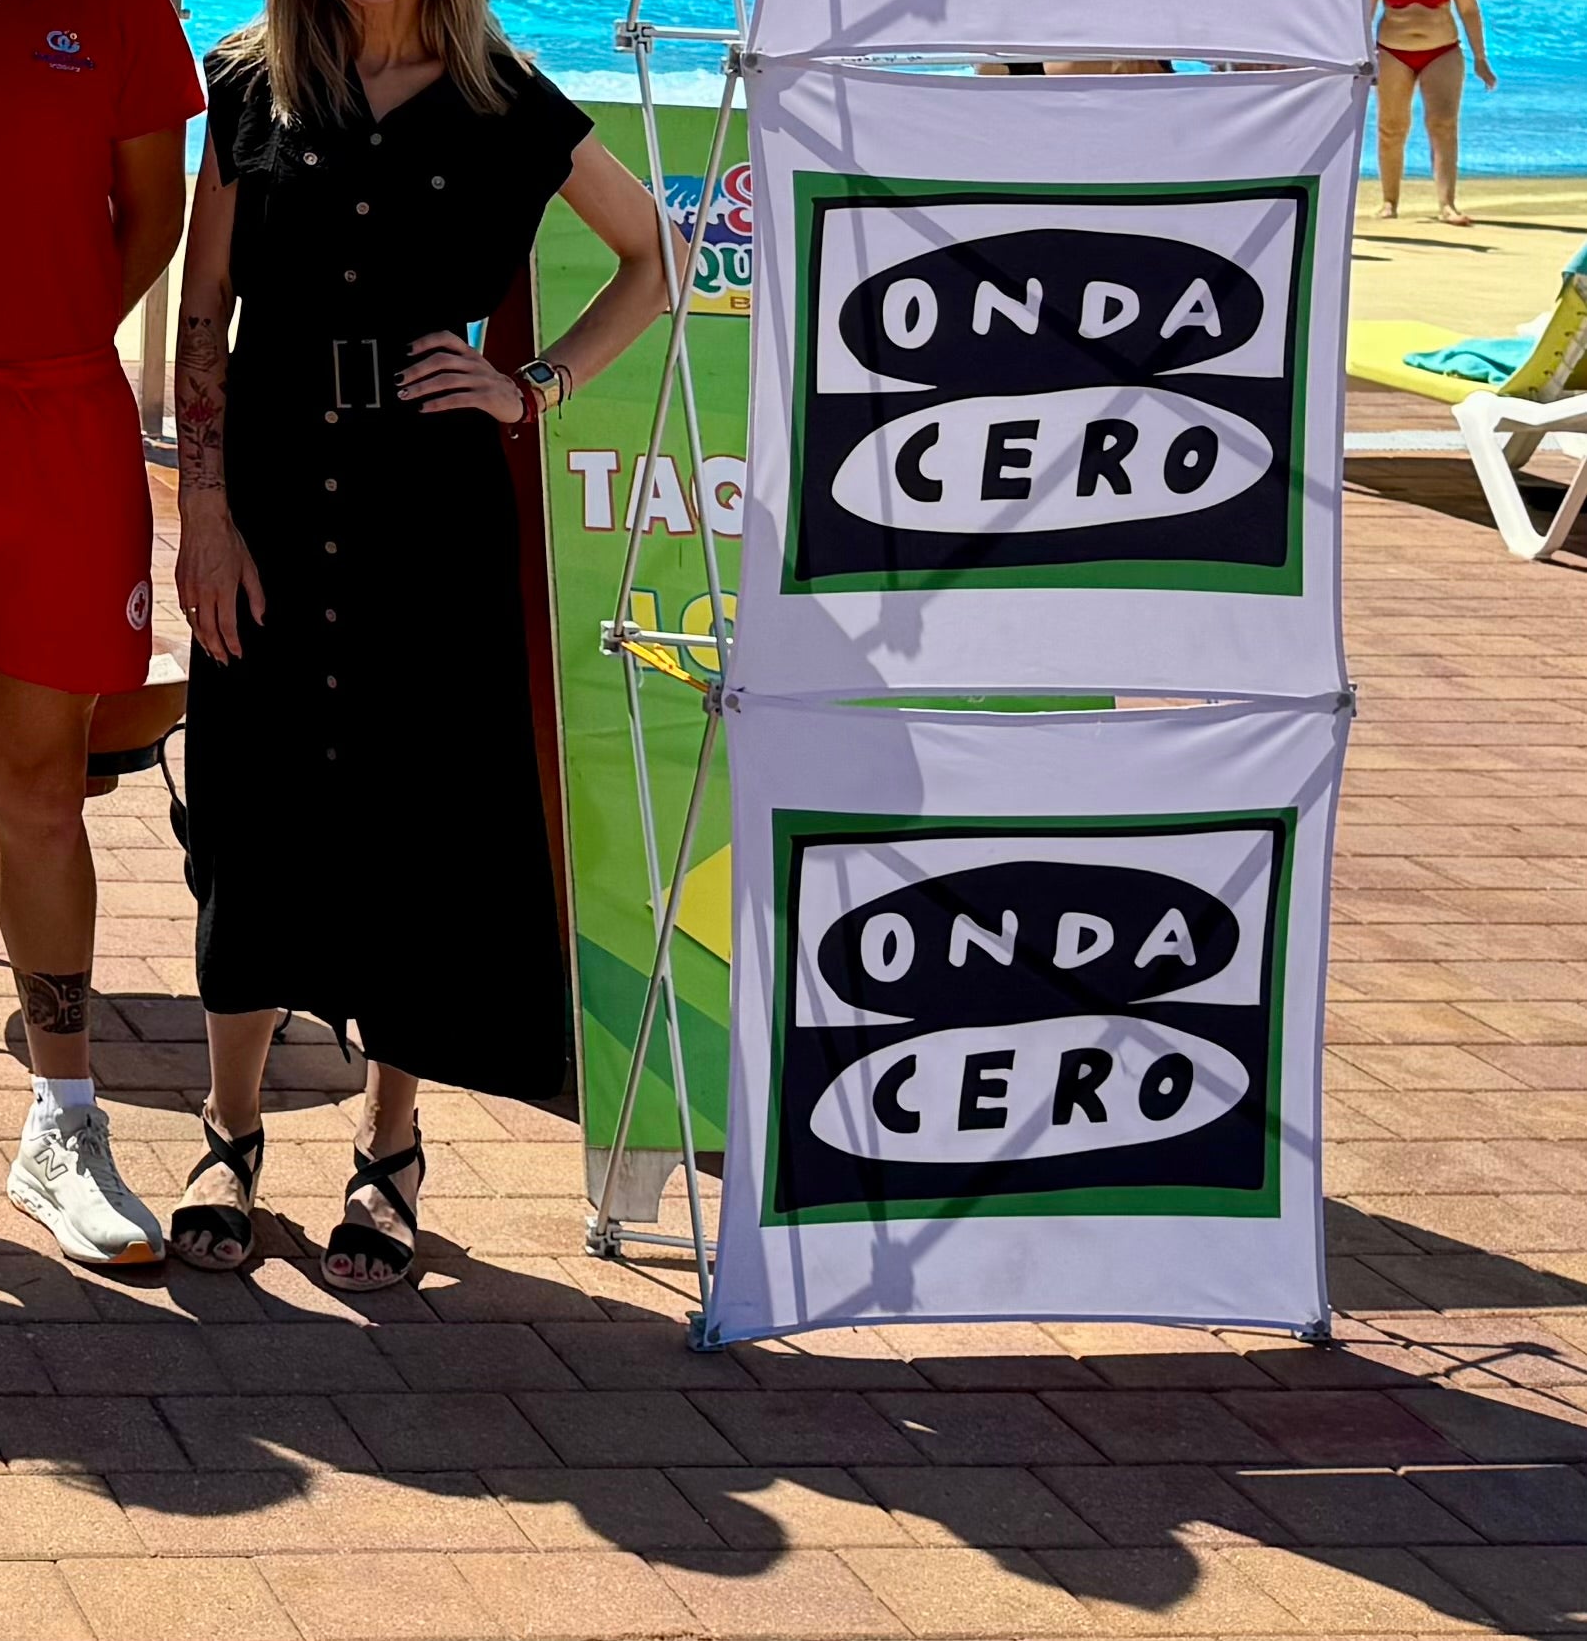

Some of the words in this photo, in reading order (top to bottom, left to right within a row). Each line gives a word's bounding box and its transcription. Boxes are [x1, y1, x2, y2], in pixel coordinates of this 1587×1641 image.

[881, 276, 1222, 350] ONDA
[894, 417, 1220, 504] CERO
[860, 907, 1197, 983] ONDA
[872, 1047, 1195, 1135] CERO
